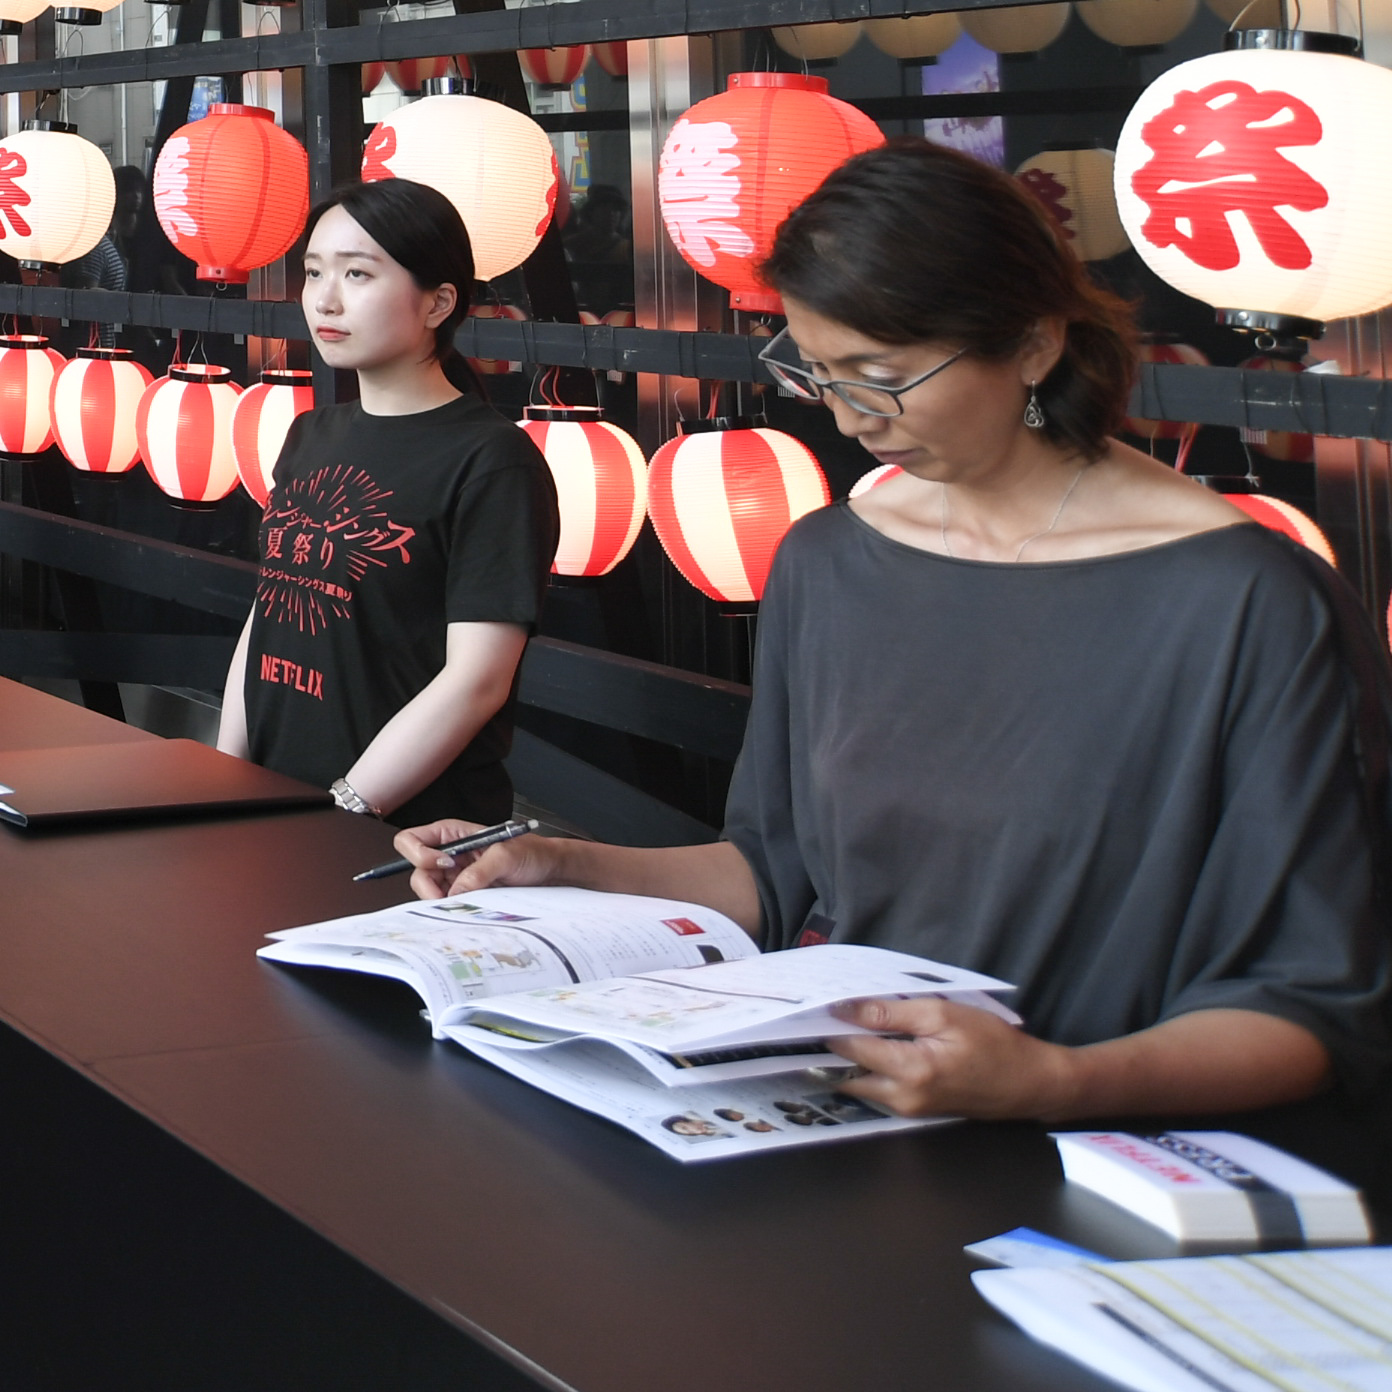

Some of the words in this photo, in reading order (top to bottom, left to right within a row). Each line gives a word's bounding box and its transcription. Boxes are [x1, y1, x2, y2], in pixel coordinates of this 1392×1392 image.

[152, 136, 200, 245] 祭
[660, 119, 755, 268] 祭
[1130, 79, 1330, 272] 祭
[265, 525, 335, 570] 夏祭り
[260, 653, 324, 701] NETFLIX
